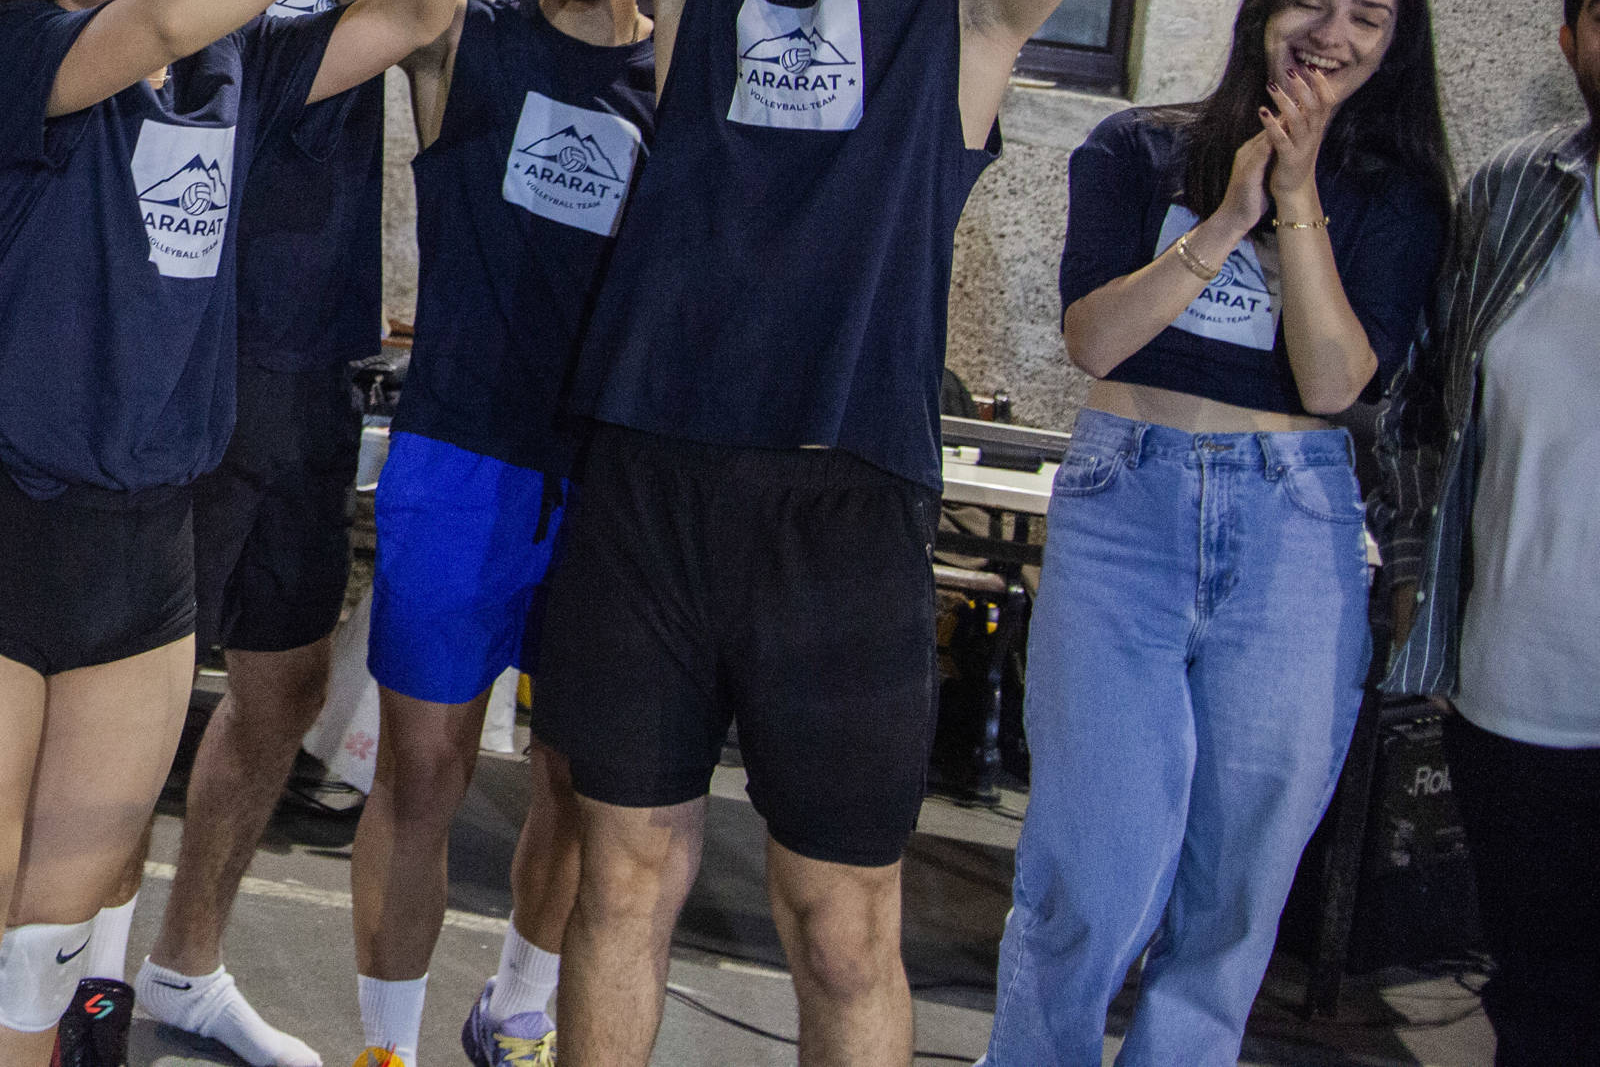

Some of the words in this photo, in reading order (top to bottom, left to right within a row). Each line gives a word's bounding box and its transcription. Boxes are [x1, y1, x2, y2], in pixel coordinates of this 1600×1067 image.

[746, 68, 842, 92] ARARAT
[750, 88, 808, 112] VOLLEYBALL
[810, 94, 837, 111] TEAM
[524, 163, 611, 199] ARARAT
[526, 180, 574, 210] VOLLEYBALL
[576, 201, 601, 210] TEAM
[144, 212, 224, 236] ARARAT
[201, 239, 219, 257] TEAM
[1198, 286, 1262, 314] ARAT
[1226, 315, 1252, 324] TEAM
